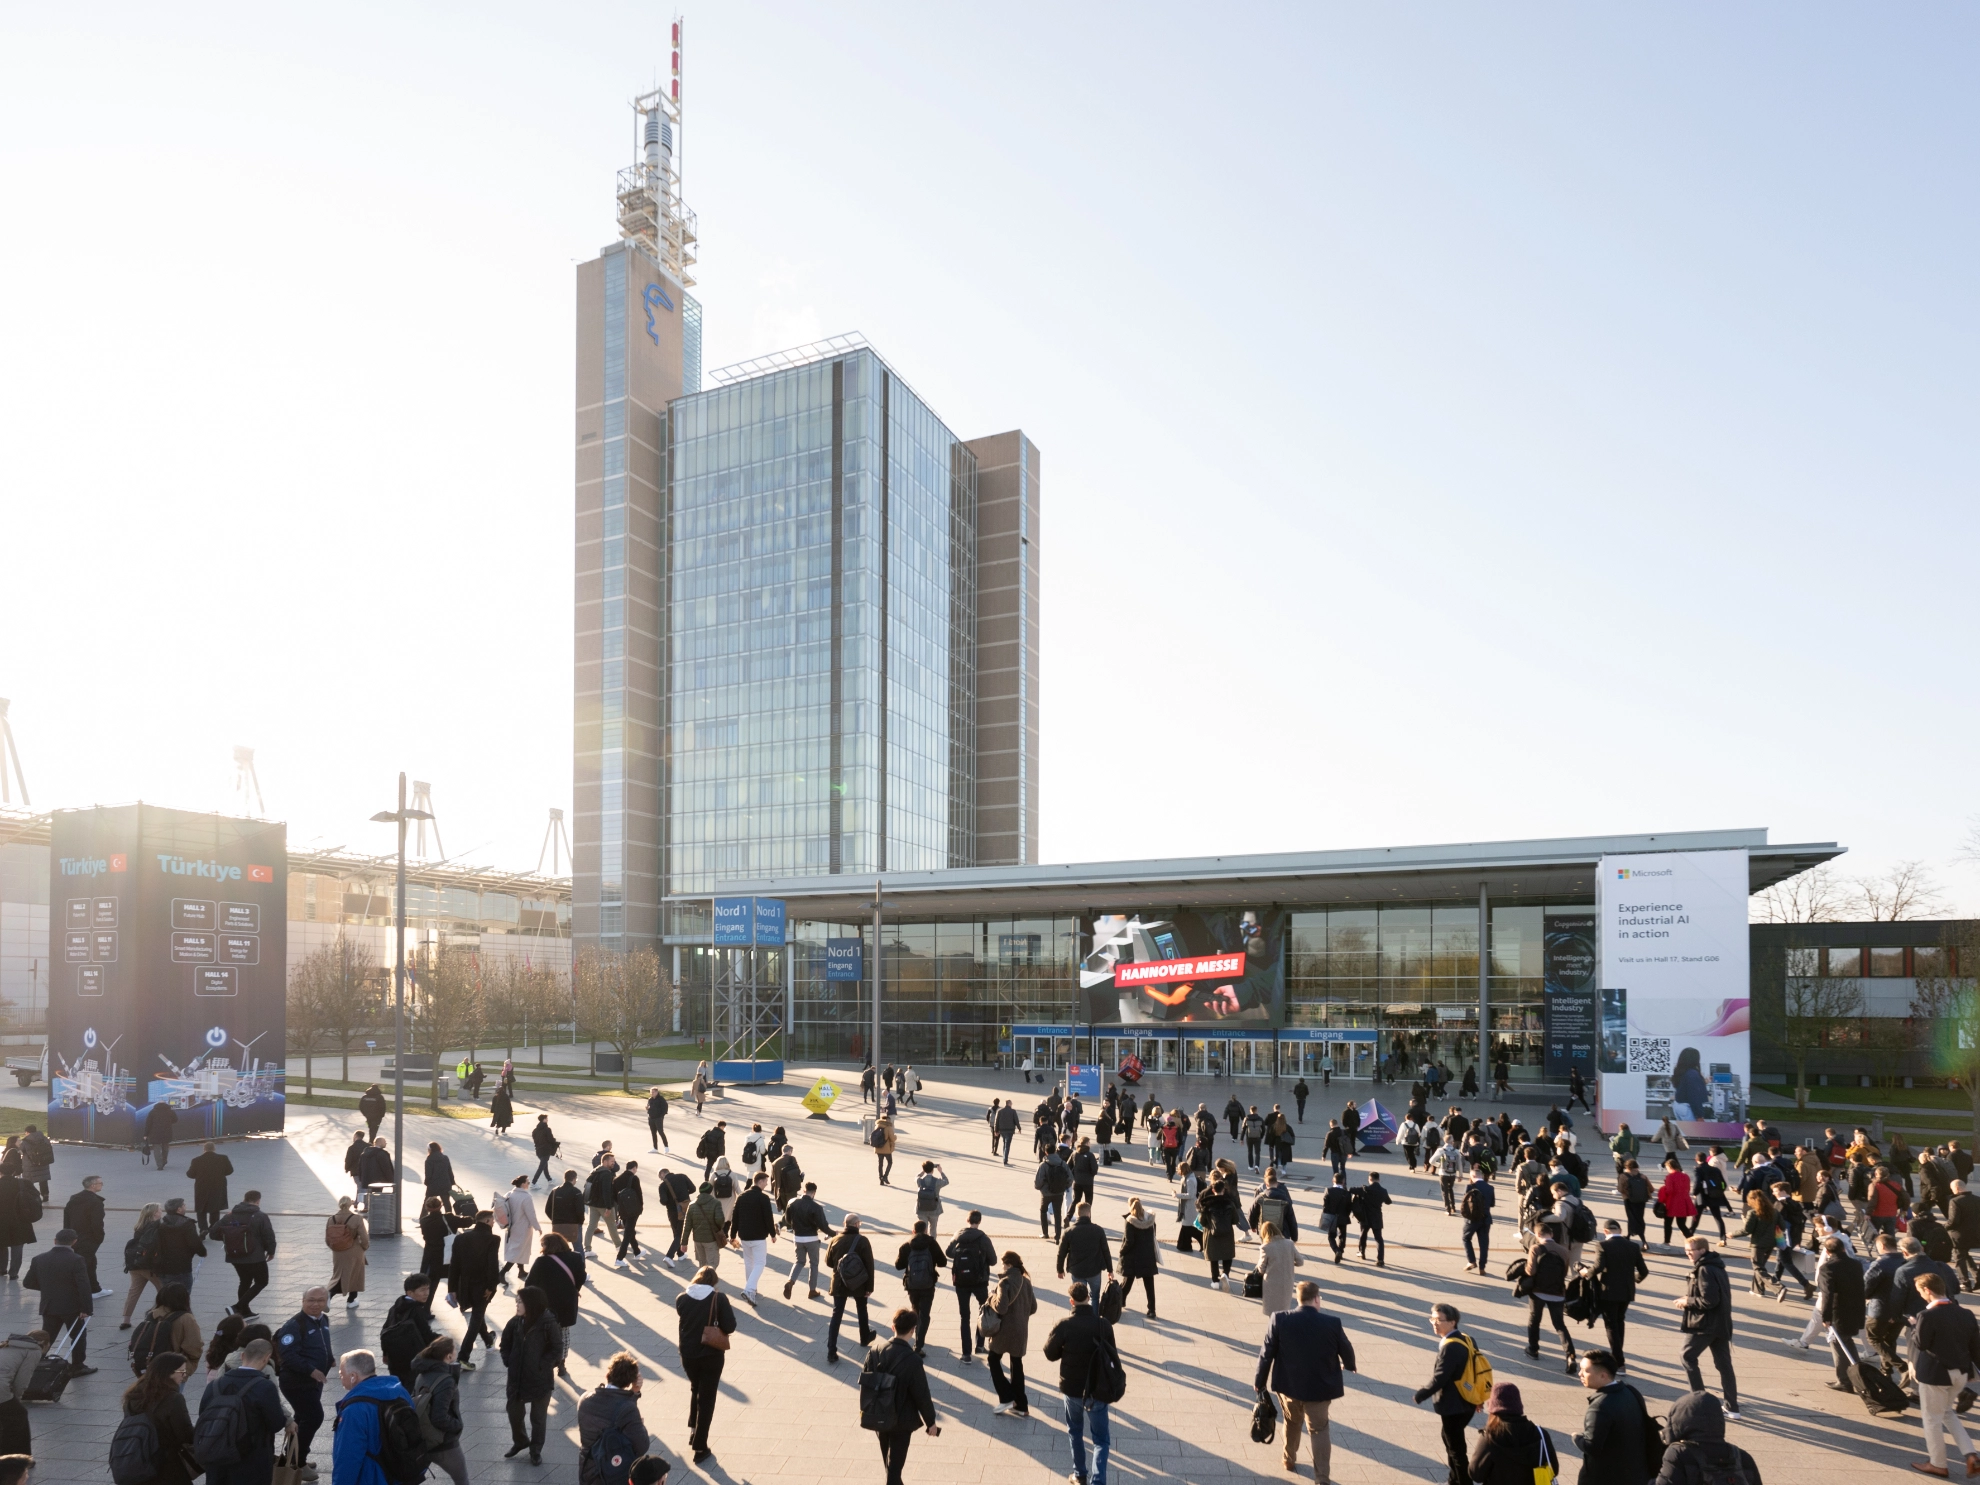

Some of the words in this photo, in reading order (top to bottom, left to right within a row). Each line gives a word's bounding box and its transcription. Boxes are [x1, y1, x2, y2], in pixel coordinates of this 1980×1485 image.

[60, 856, 107, 878] Türkiye
[157, 854, 242, 882] Türkiye
[1632, 869, 1672, 877] Microsoft
[715, 905, 740, 916] Nord
[742, 906, 746, 916] 1
[756, 905, 776, 917] Nord
[777, 908, 780, 918] 1
[1618, 902, 1683, 914] Experience
[1618, 916, 1674, 926] industrial
[1677, 915, 1690, 924] AI
[715, 924, 744, 933] Eingang
[756, 922, 779, 934] Eingang
[1618, 930, 1629, 938] in
[1632, 928, 1670, 938] action
[715, 934, 746, 942] Entrance
[756, 932, 780, 942] Entrance
[828, 946, 853, 957] Nord
[856, 947, 860, 956] 1
[828, 962, 853, 970] Eingang
[1120, 963, 1194, 980] HANNOVER
[1196, 958, 1238, 974] MESSE
[1123, 1028, 1152, 1036] Eingang
[1310, 1030, 1344, 1040] Eingang
